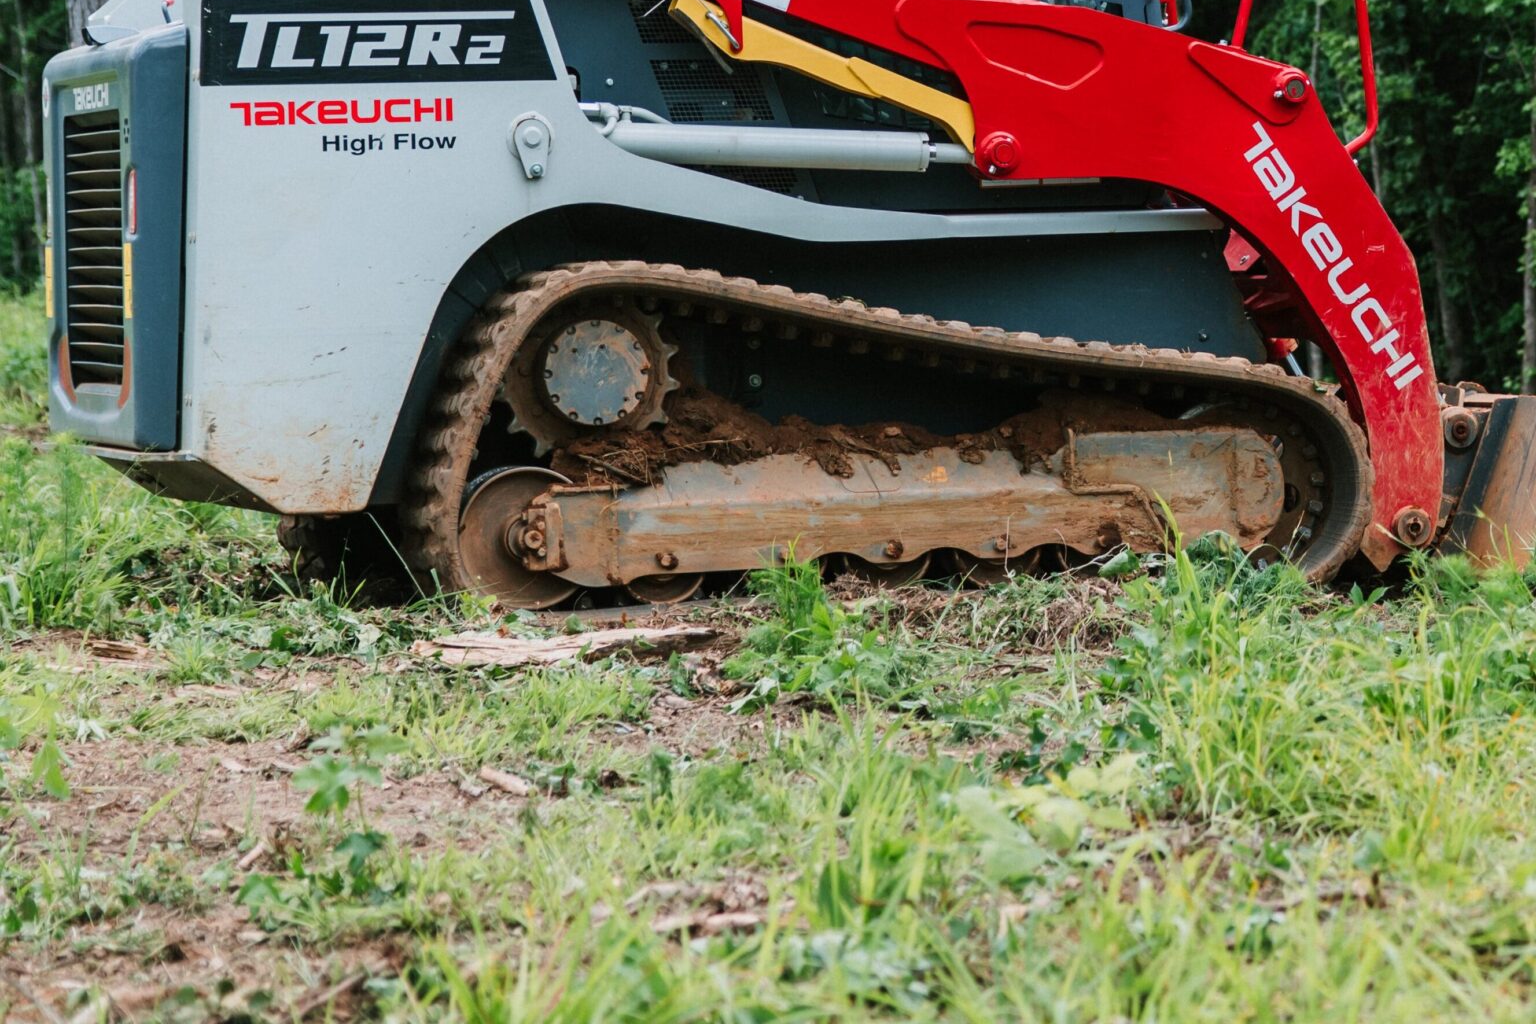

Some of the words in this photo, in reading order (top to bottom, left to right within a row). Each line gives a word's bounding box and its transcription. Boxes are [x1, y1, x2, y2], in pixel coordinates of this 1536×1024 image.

[229, 10, 516, 68] TL12R2
[322, 134, 384, 155] High
[394, 133, 456, 150] Flow
